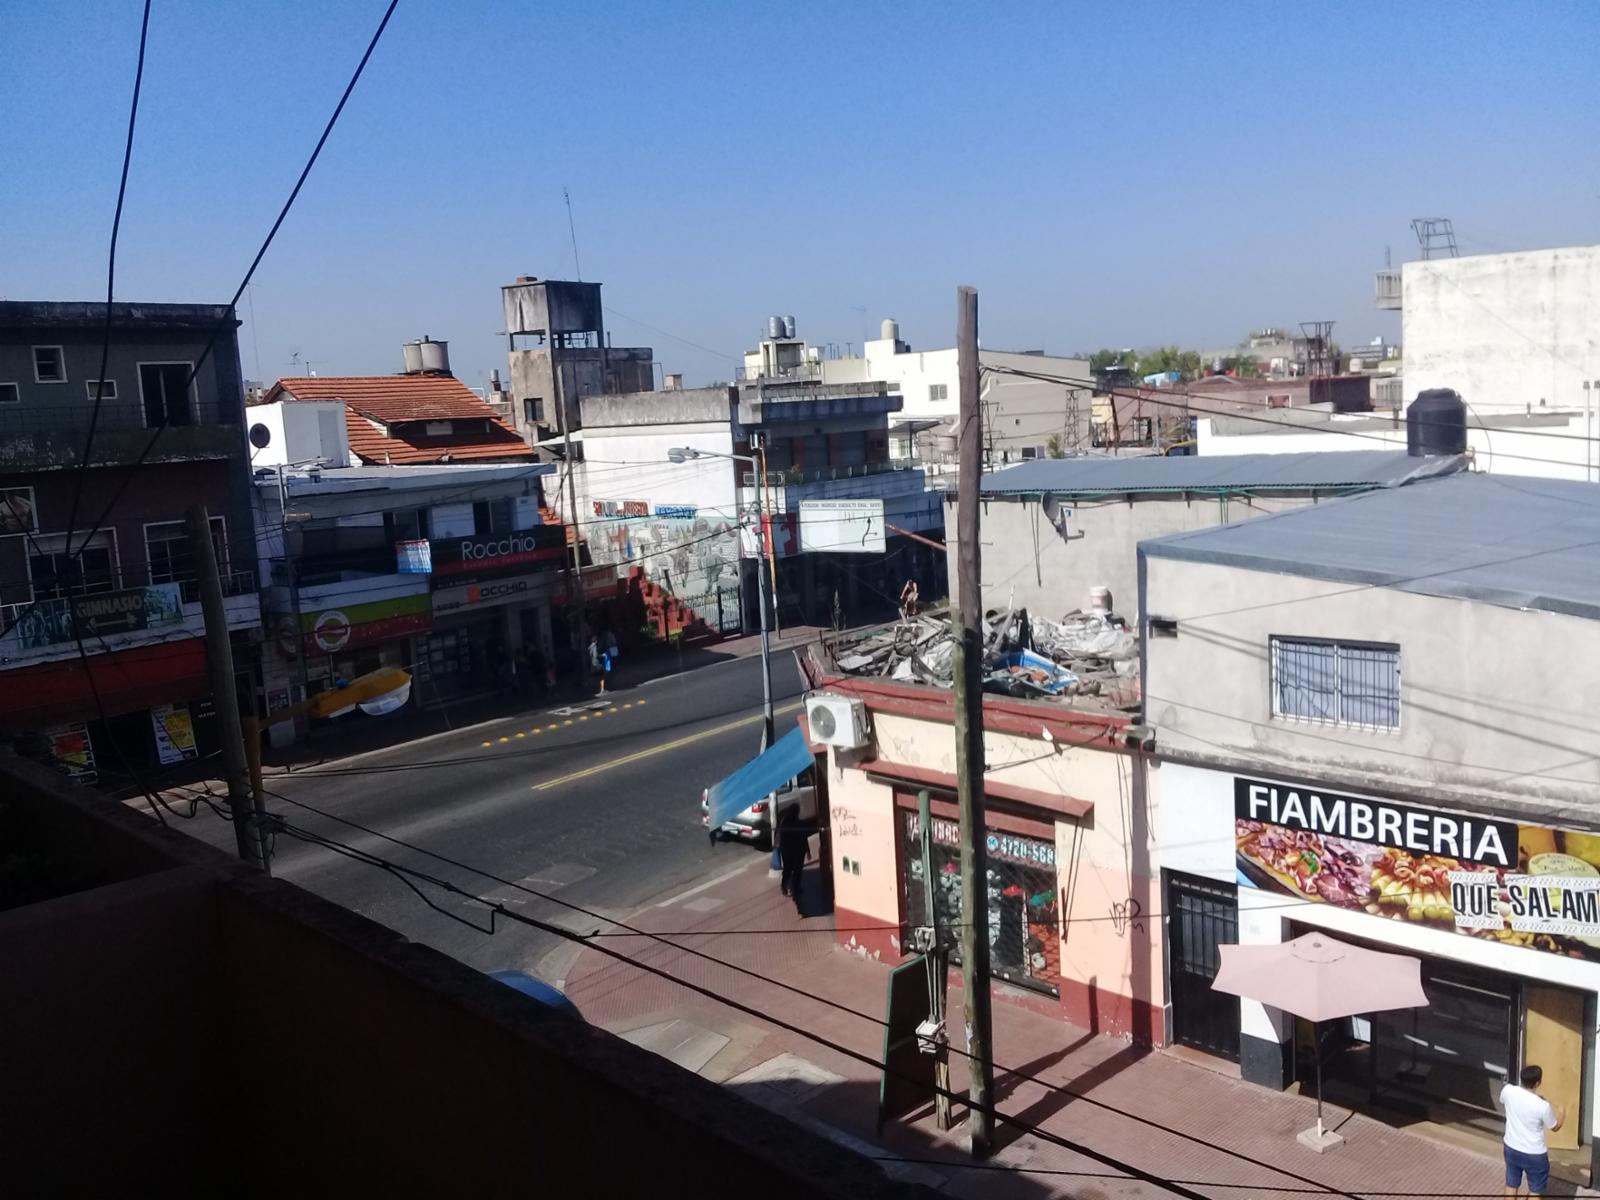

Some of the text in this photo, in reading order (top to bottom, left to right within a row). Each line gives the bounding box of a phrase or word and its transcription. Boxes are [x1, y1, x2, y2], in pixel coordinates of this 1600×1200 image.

[461, 533, 536, 560] Rocchio
[76, 595, 144, 619] GIMNASIO
[1249, 785, 1509, 865] FIAMBRERIA
[1452, 882, 1498, 917] QUE
